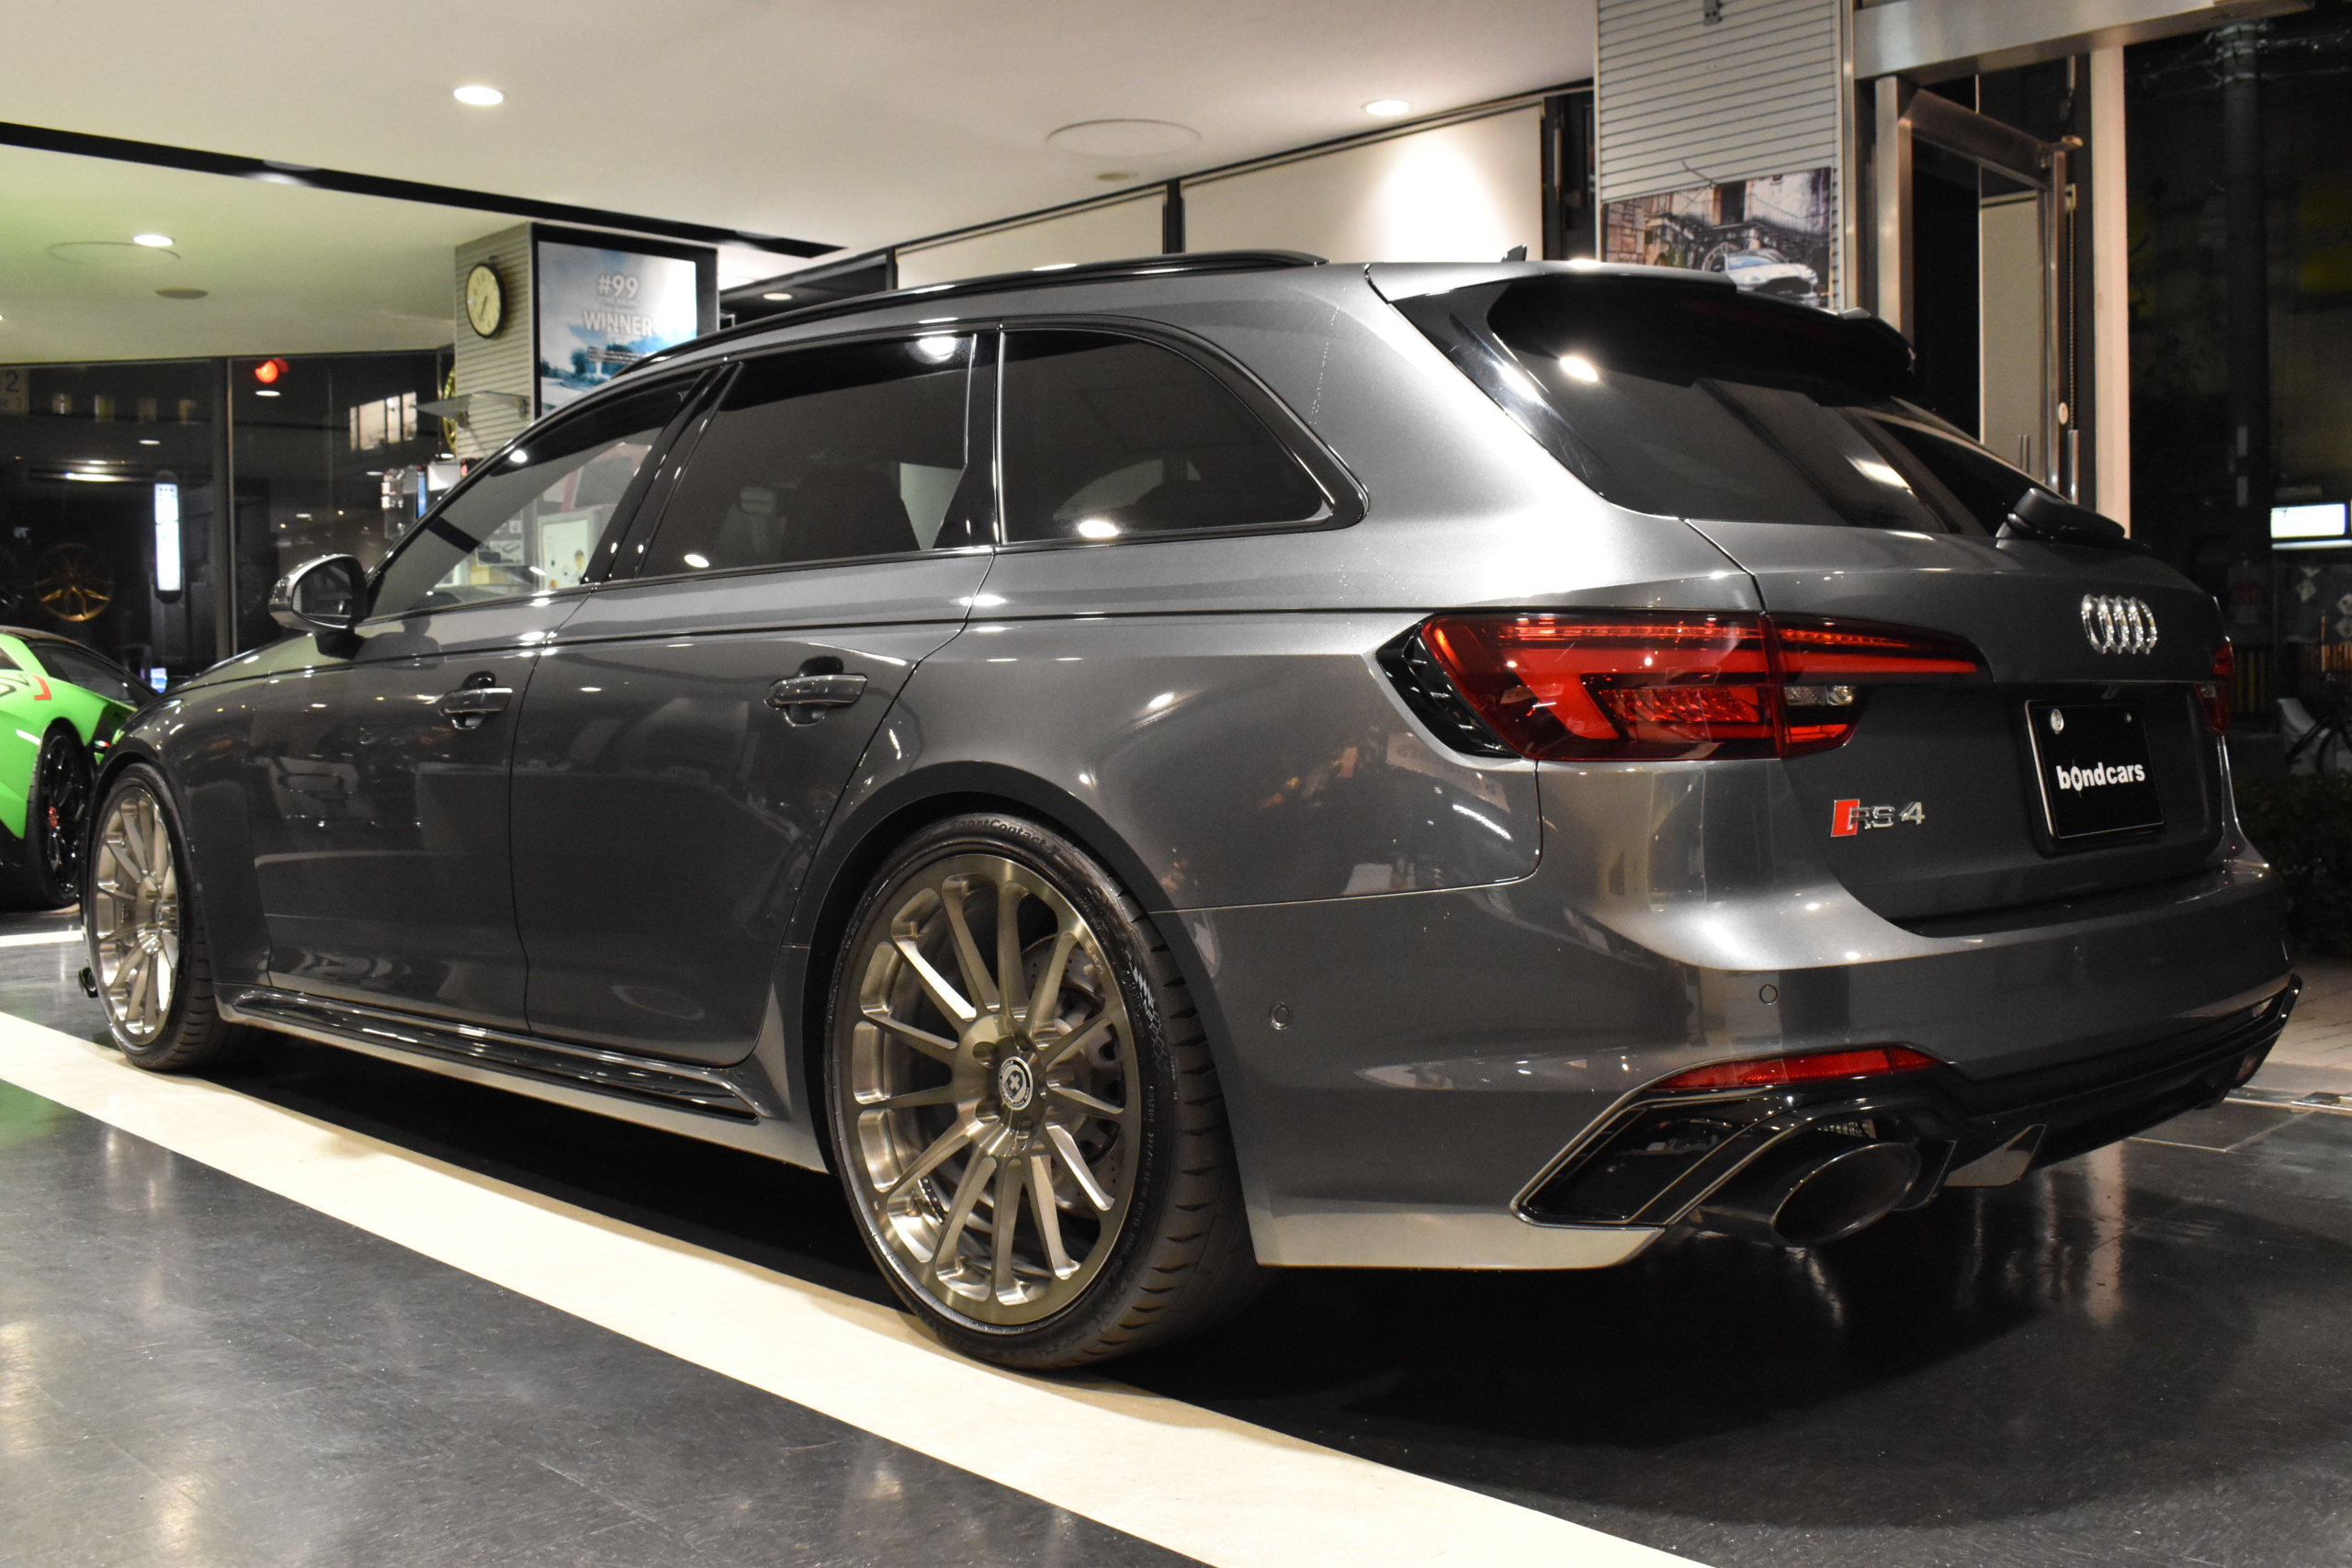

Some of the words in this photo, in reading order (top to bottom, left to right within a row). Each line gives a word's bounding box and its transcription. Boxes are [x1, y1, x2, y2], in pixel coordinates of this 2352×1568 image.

[597, 275, 639, 299] #99
[582, 310, 653, 338] WINNER
[2056, 761, 2146, 793] bondcars
